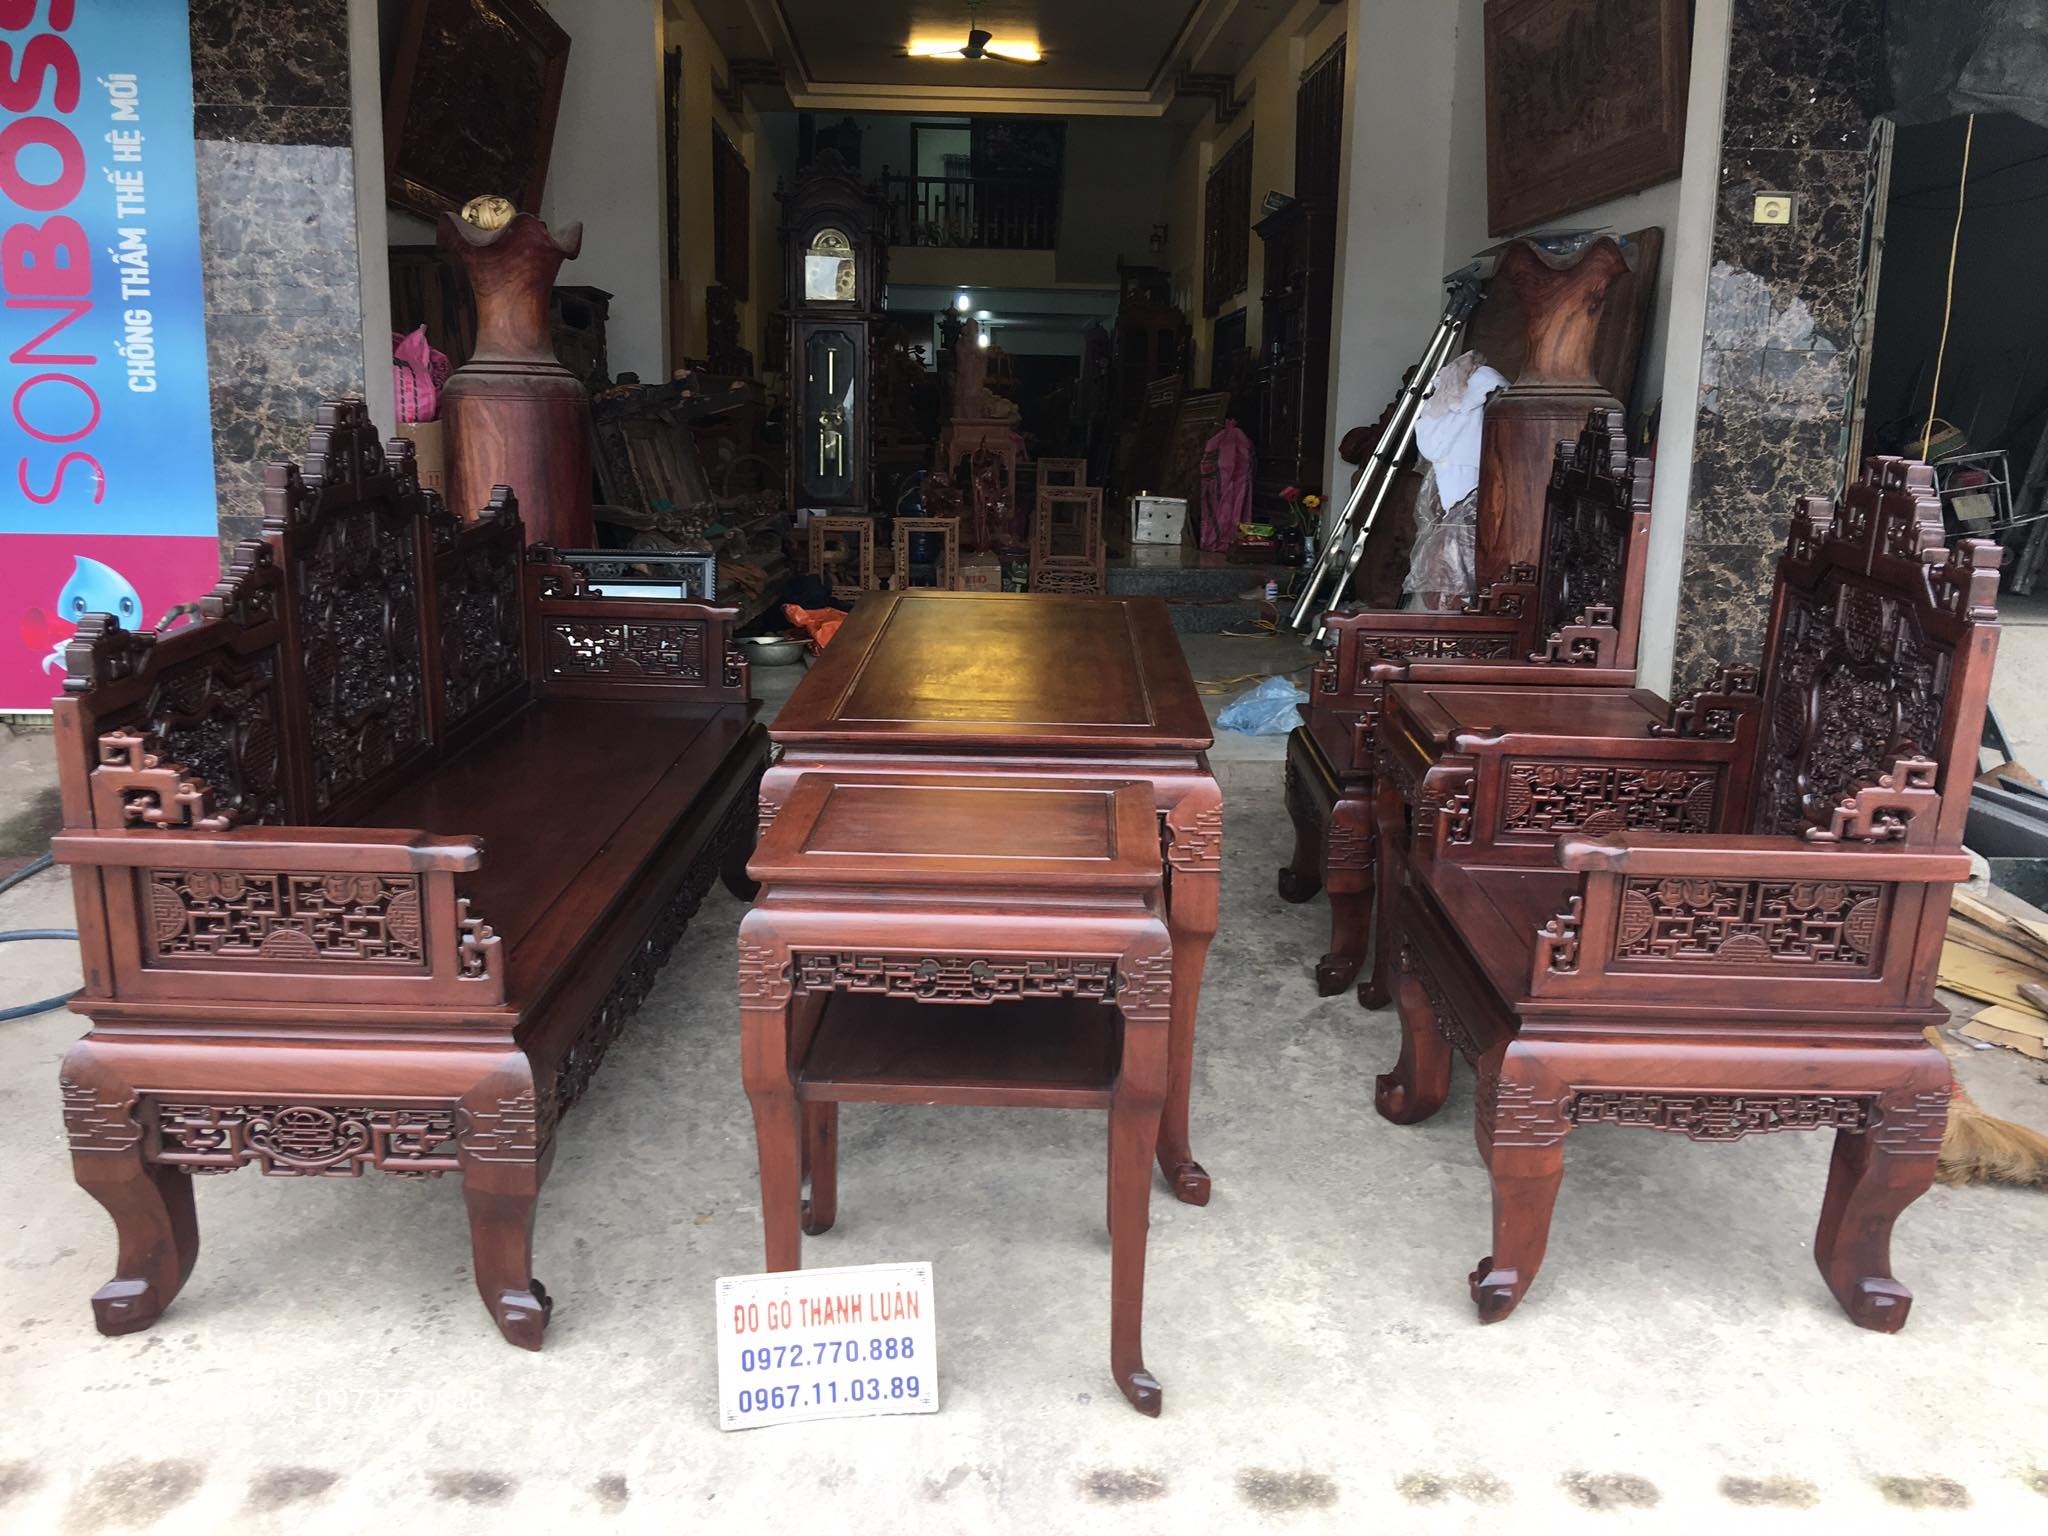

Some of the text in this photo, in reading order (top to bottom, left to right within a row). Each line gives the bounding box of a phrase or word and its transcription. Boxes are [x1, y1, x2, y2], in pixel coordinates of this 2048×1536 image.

[97, 74, 157, 393] CHỐNG THẤM THẾ HỆ MỚI
[799, 1293, 862, 1328] THANH
[741, 1337, 915, 1373] 0972.770.888
[738, 1376, 920, 1413] 0967.11.03.89
